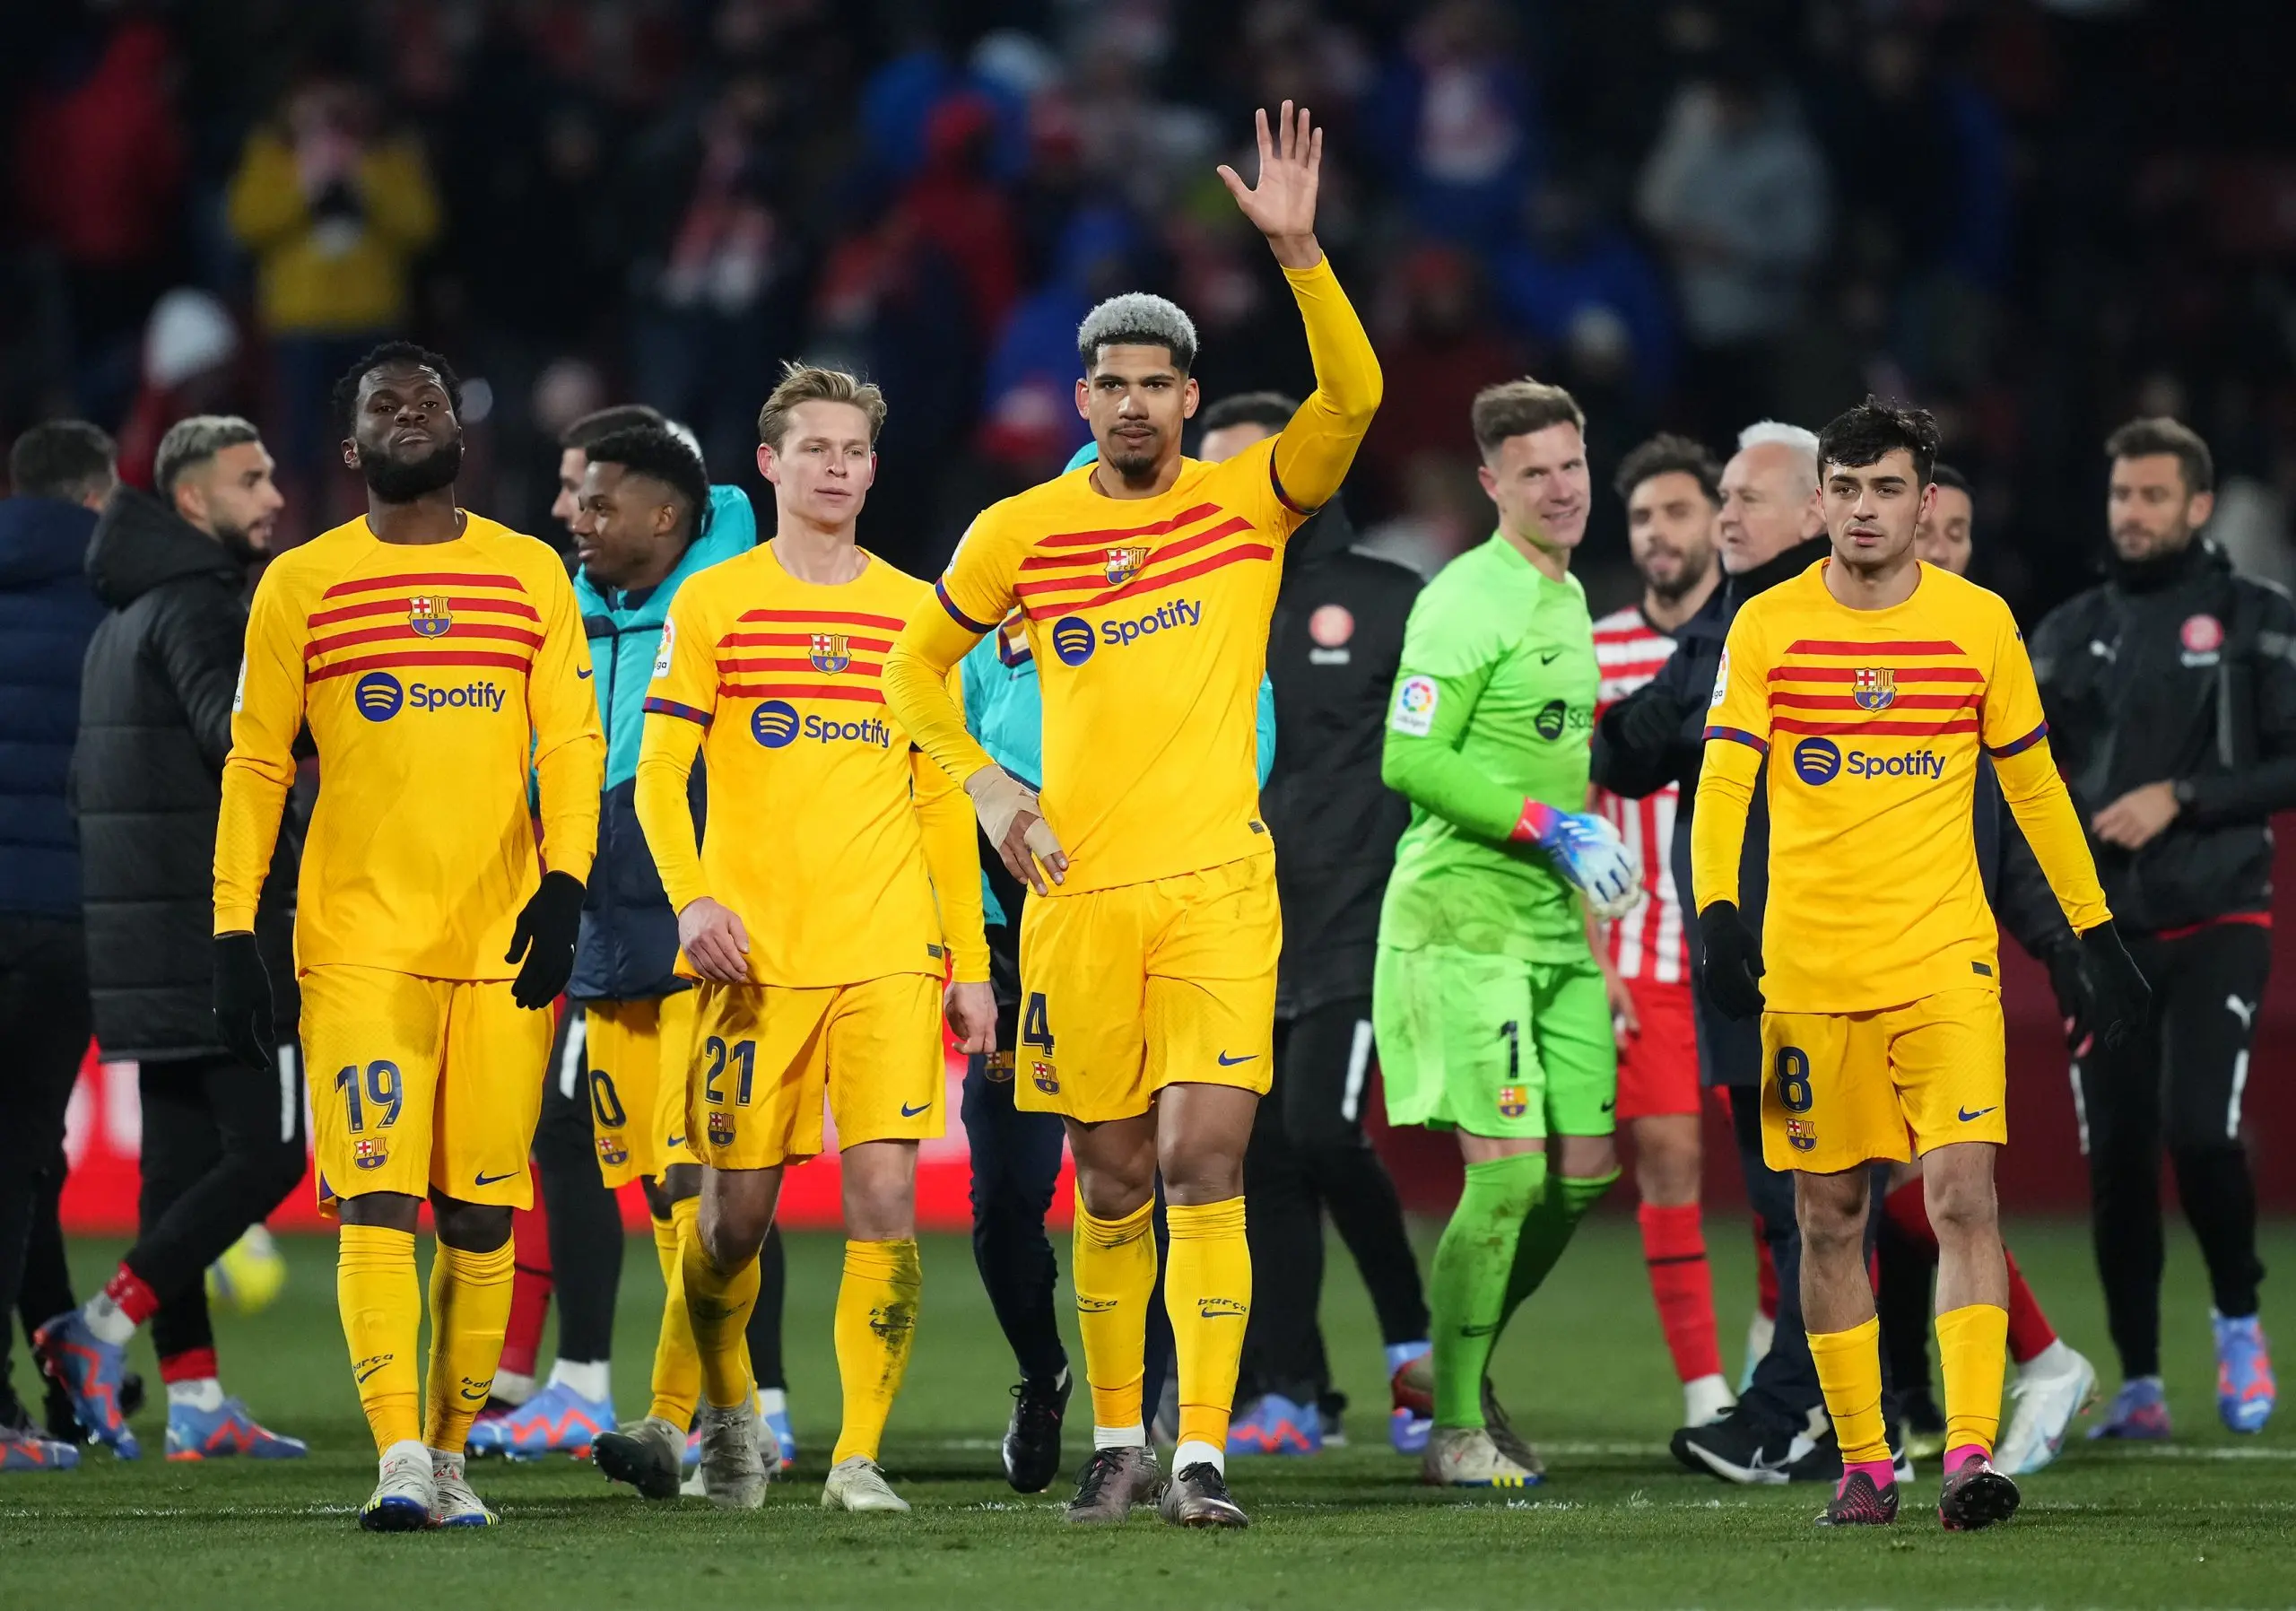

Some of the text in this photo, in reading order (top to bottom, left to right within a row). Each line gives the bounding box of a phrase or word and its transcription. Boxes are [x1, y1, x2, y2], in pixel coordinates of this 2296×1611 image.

[1101, 598, 1201, 647] Spotify
[409, 681, 506, 712] Spotify
[804, 715, 890, 748] Spotify
[1847, 750, 1946, 779] Spotify
[1022, 992, 1055, 1058] 4
[1497, 1020, 1518, 1079] 1
[335, 1060, 403, 1135] 19
[705, 1035, 756, 1108] 21
[1775, 1046, 1813, 1114] 8
